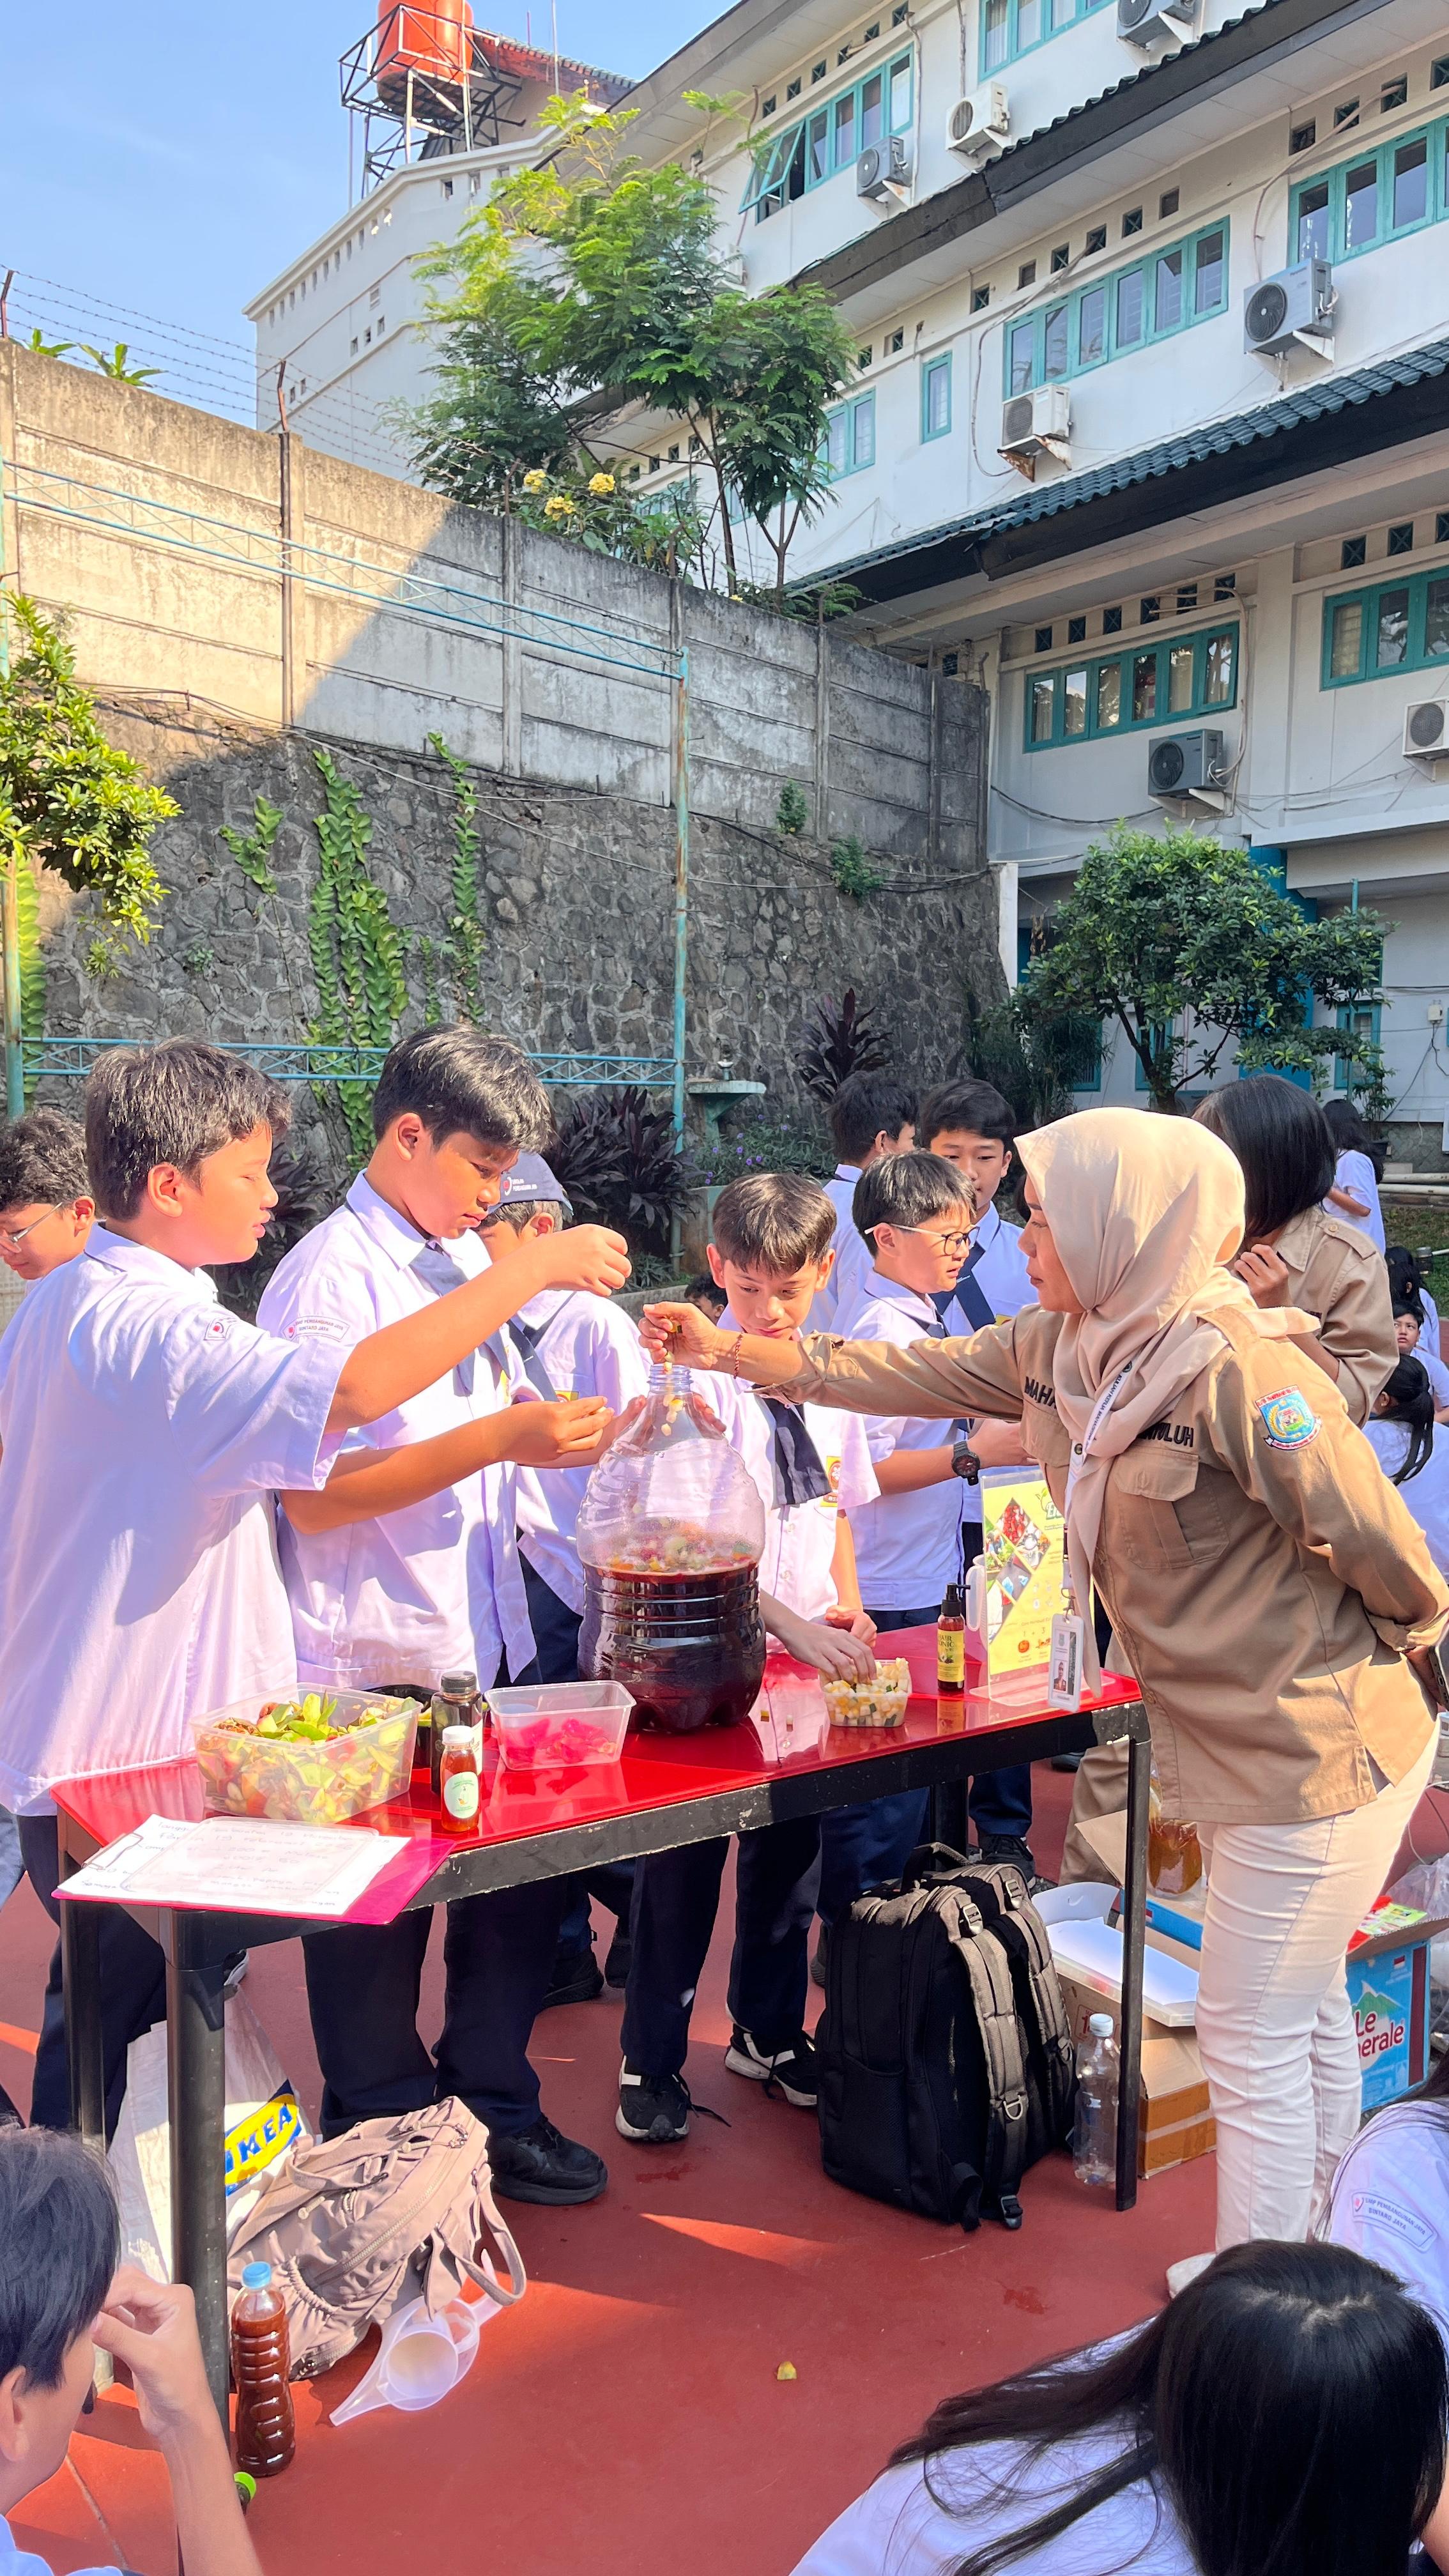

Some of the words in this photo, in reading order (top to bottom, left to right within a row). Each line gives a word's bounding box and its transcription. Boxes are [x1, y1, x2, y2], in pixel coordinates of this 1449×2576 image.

[1355, 2011, 1377, 2037] Le
[1358, 2021, 1404, 2058] erale
[225, 2102, 293, 2174] IKEA
